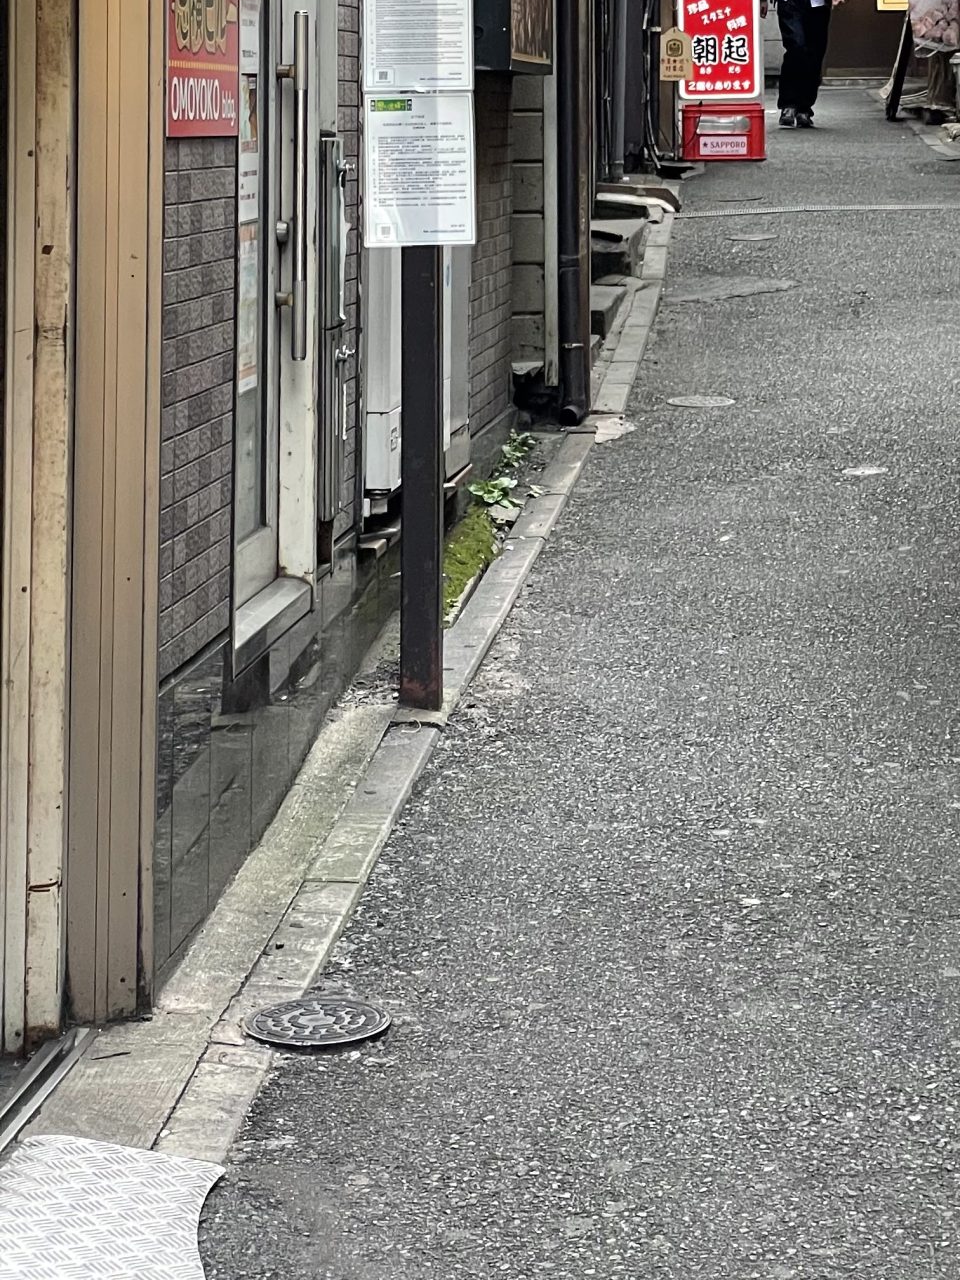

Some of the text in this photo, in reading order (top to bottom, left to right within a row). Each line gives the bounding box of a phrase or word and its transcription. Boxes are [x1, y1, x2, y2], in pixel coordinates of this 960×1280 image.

[701, 6, 732, 26] スタミナ
[692, 35, 749, 65] 朝起
[171, 76, 237, 127] OMOYOKO bldg.
[710, 141, 746, 149] SAPPORO
